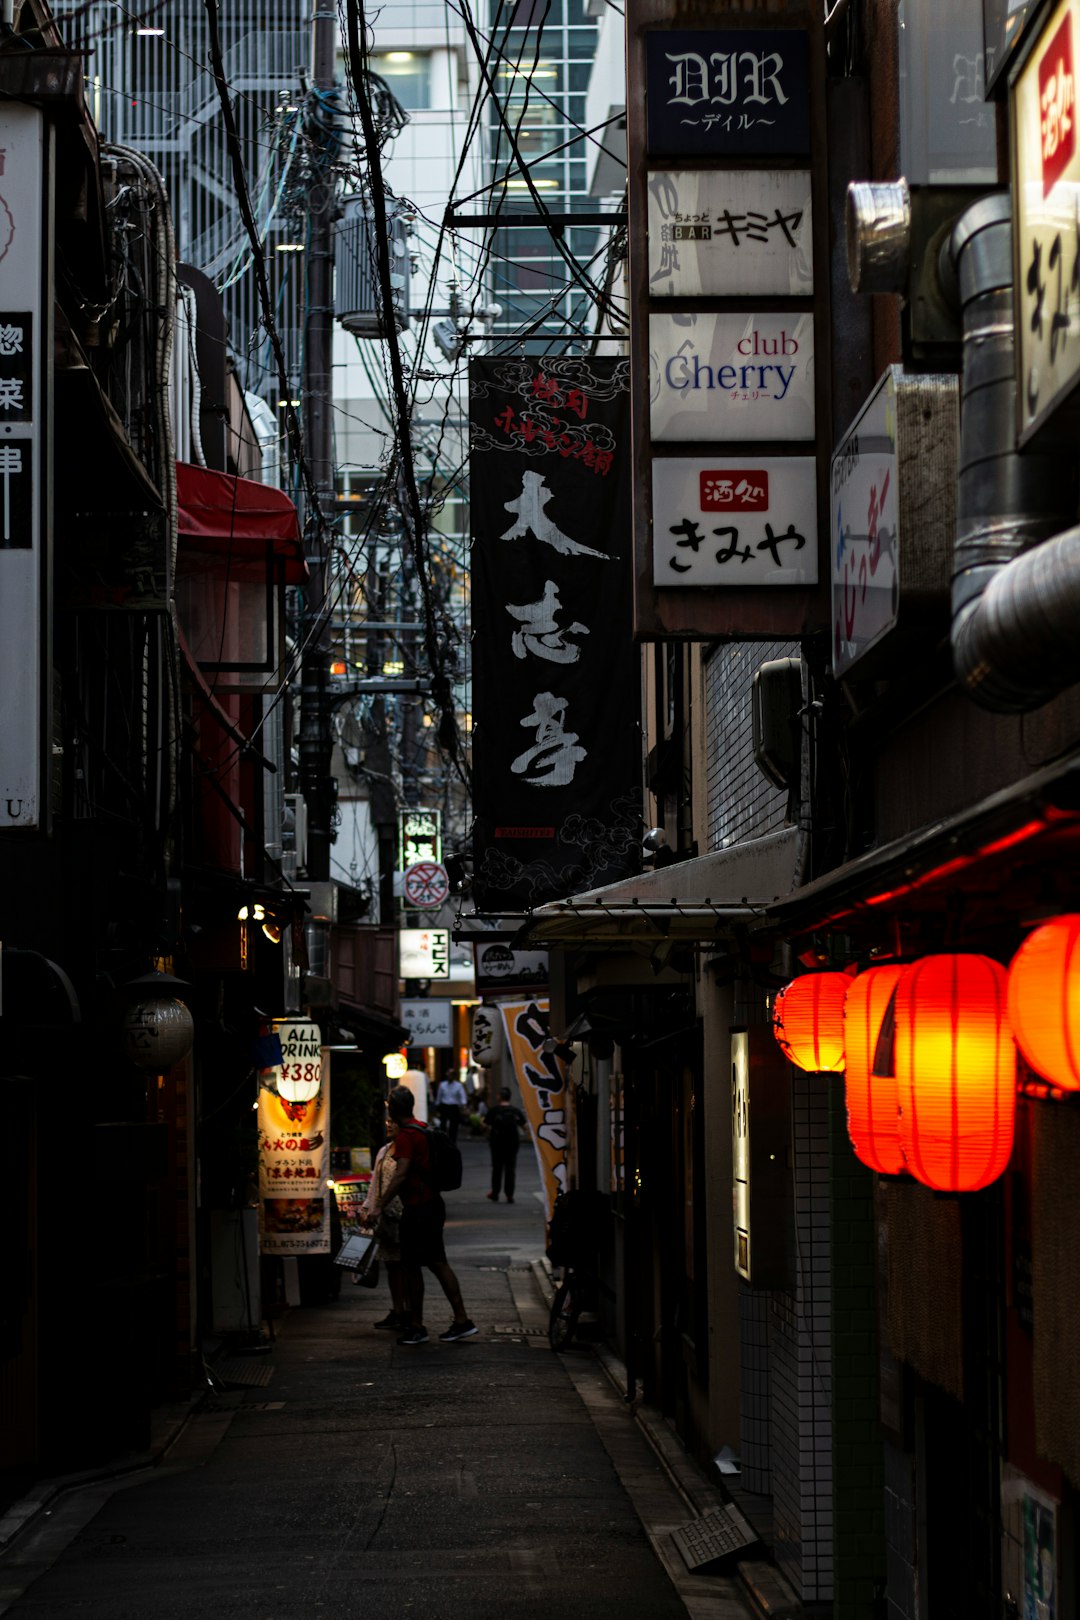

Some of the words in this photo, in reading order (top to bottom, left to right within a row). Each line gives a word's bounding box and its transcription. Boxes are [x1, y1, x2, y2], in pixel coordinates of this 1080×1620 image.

[664, 51, 790, 106] DIR
[675, 212, 710, 223] ちょっと
[714, 209, 803, 248] キミヤ
[674, 226, 710, 240] BAR
[737, 330, 798, 356] club
[665, 355, 797, 400] Cherry
[730, 391, 771, 401] チェリー
[703, 478, 765, 503] 酒処
[669, 518, 806, 573] きみや
[432, 934, 446, 974] エビス
[287, 1029, 318, 1042] ALL
